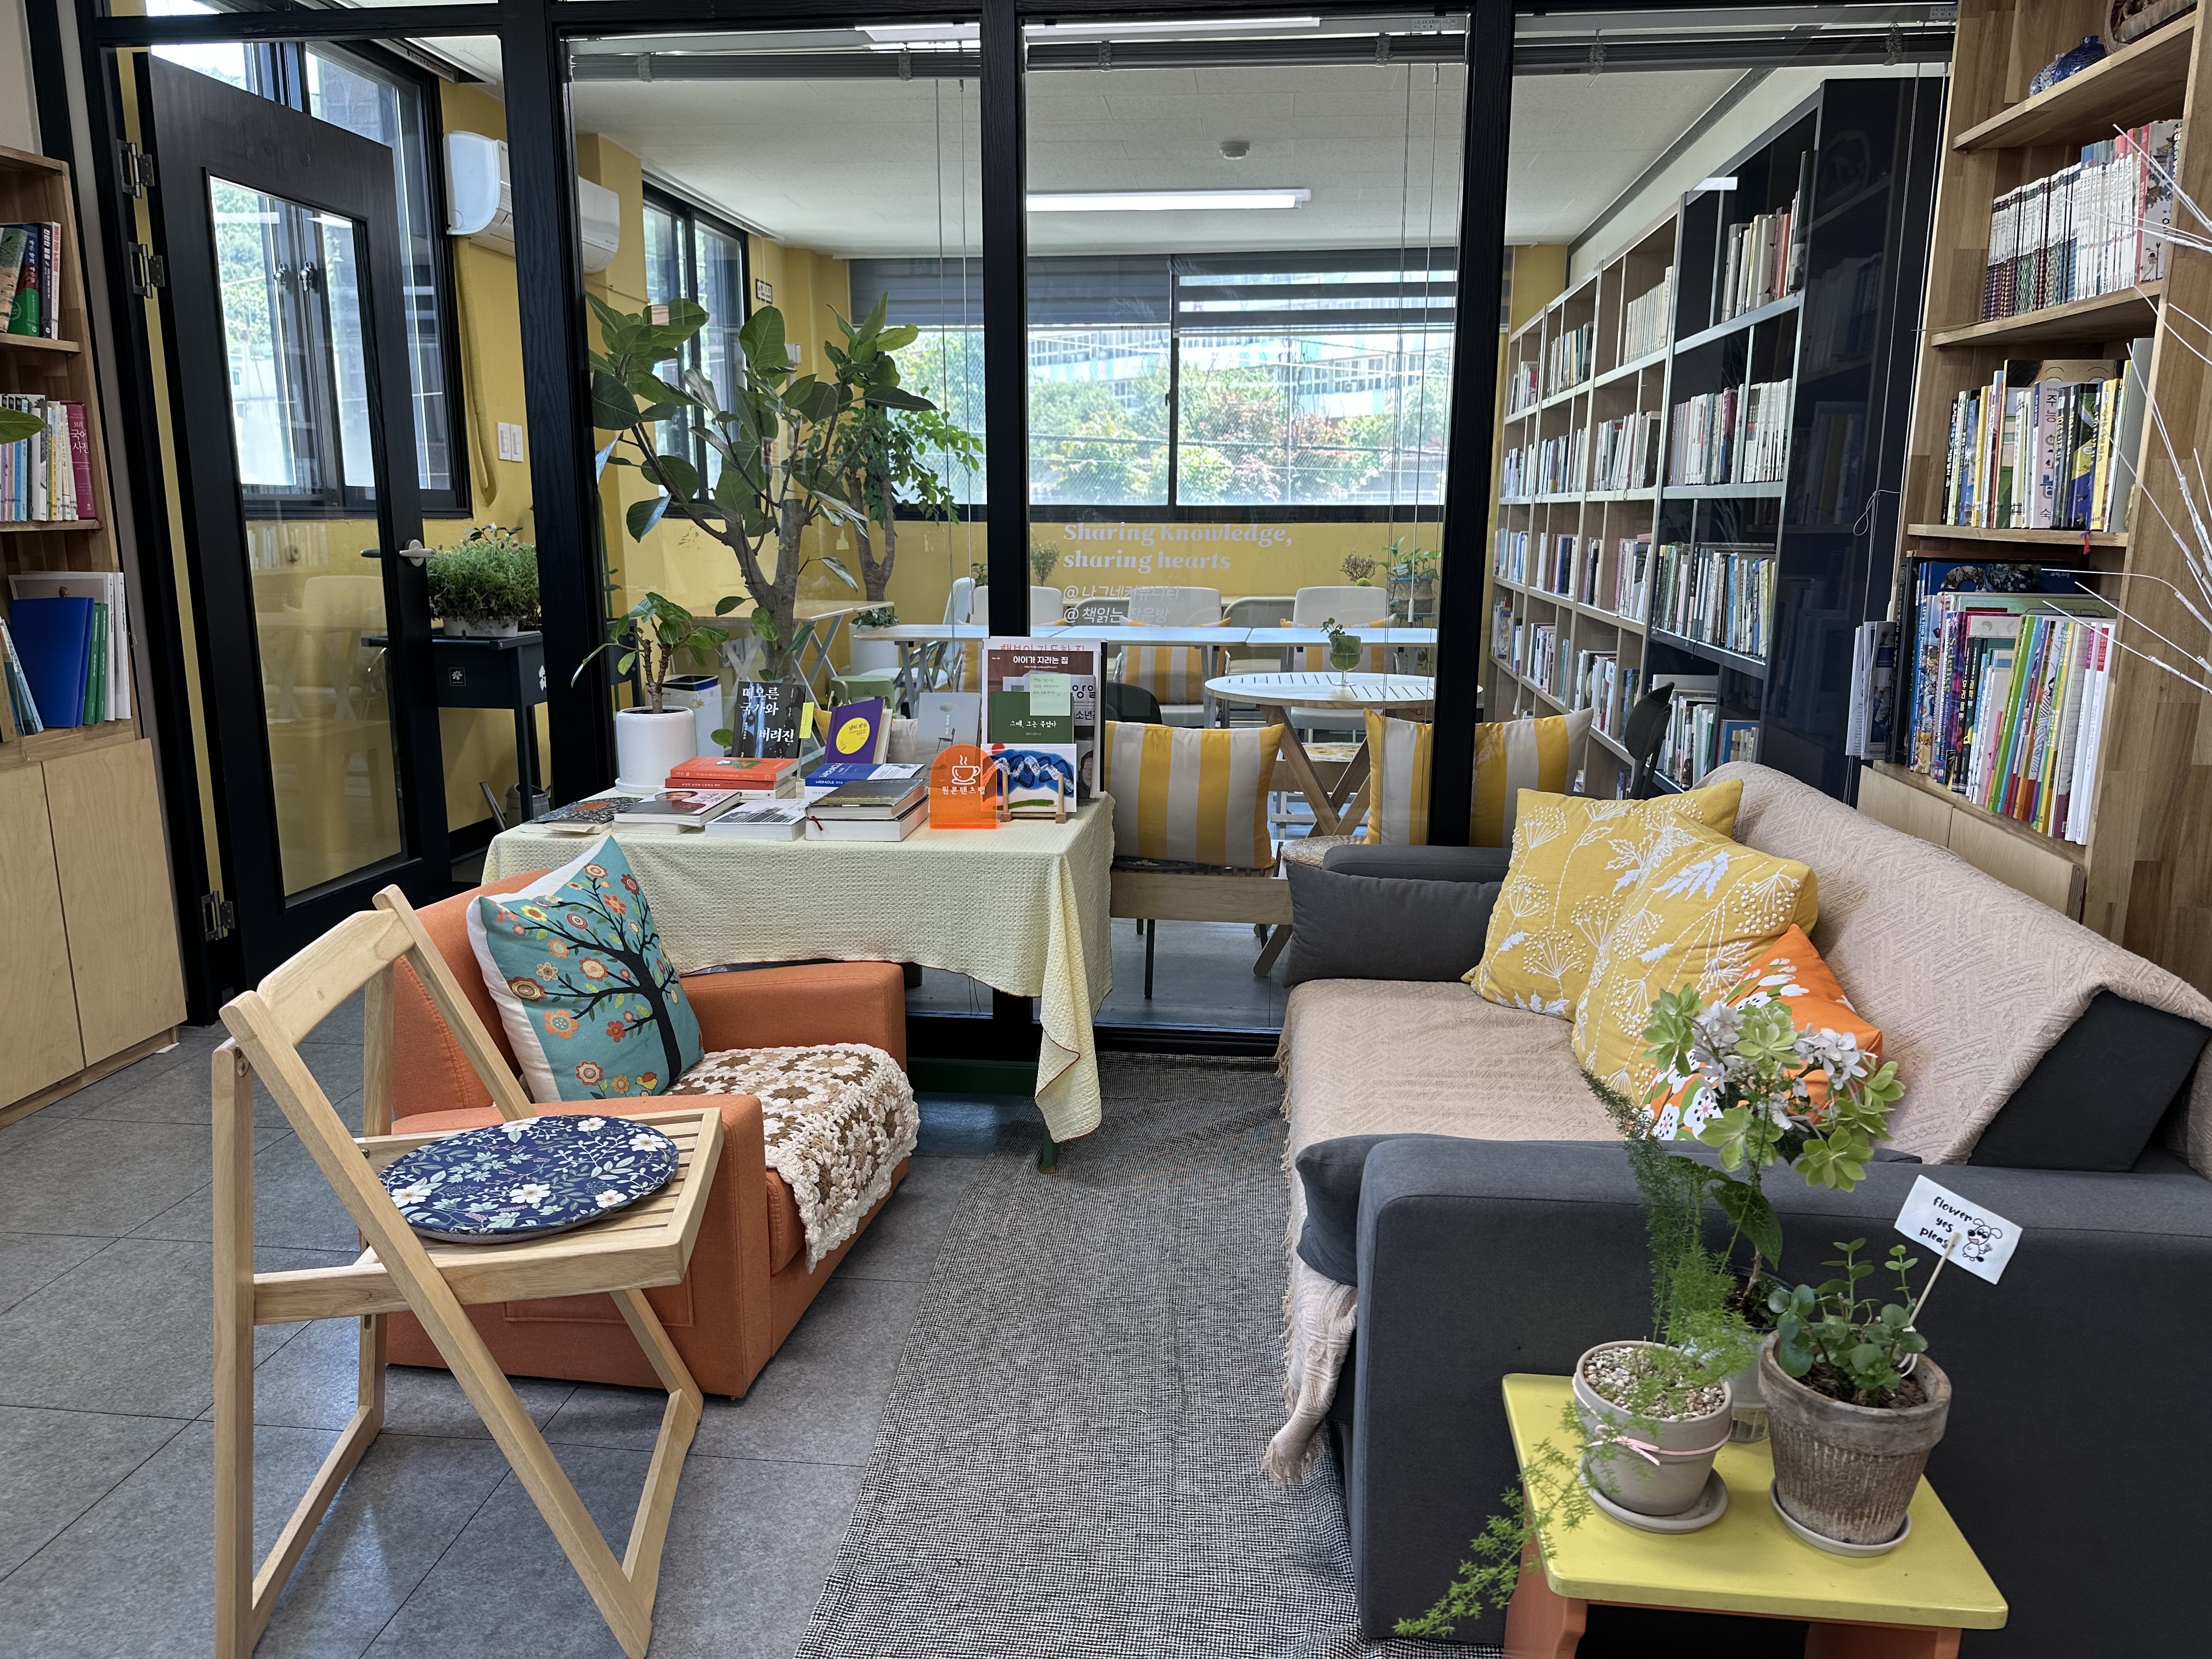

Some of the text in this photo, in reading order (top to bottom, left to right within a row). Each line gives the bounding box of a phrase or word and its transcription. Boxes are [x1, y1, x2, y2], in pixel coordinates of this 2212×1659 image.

[70, 429, 87, 441] 국어
[72, 442, 89, 454] 사전
[1063, 522, 1155, 546] Sharing
[1063, 549, 1231, 574] sharing hearts
[1013, 656, 1035, 664] 아이가
[1061, 656, 1069, 664] 집
[1946, 636, 1956, 692] Science
[742, 686, 780, 700] 떠오른
[740, 701, 779, 716] 국가와
[759, 727, 794, 743] 버려진
[1933, 1196, 1973, 1222] flower
[1935, 1216, 1954, 1233] yes
[1919, 1227, 1955, 1251] pleas
